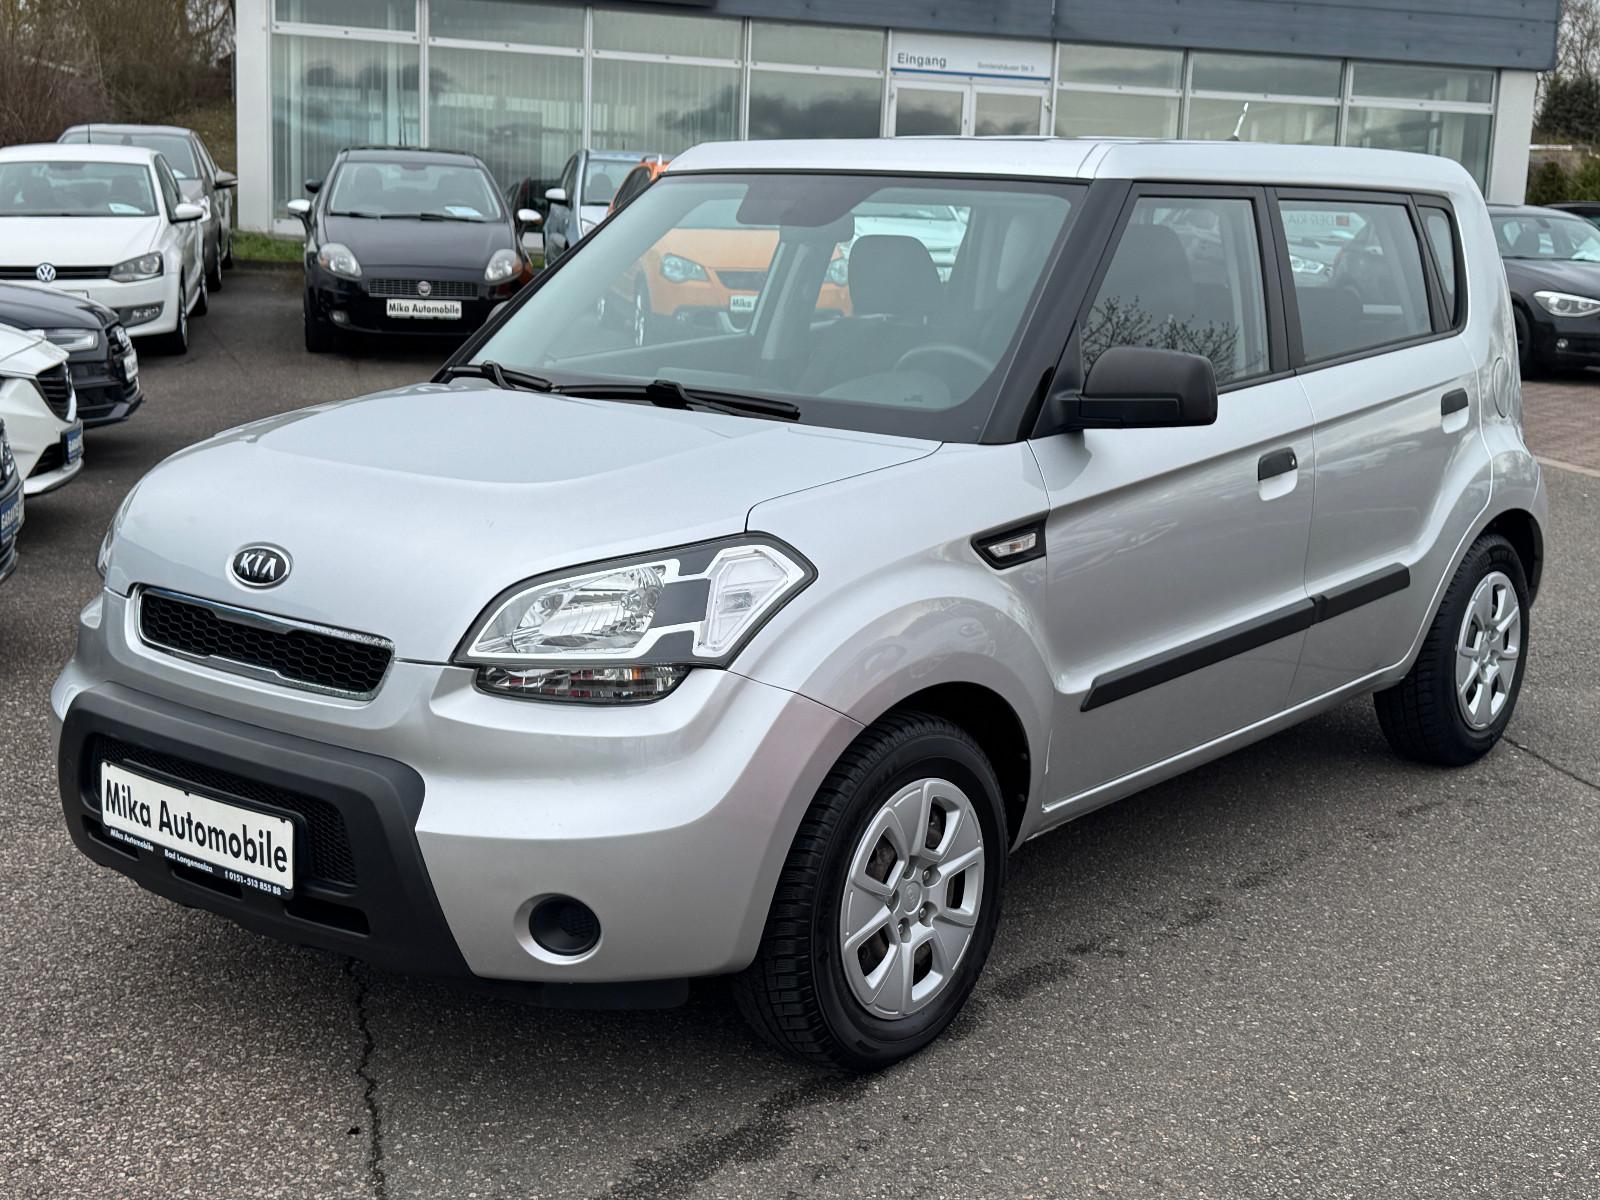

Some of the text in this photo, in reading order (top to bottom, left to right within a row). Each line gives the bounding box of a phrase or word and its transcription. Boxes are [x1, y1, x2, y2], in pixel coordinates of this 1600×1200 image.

[897, 53, 947, 68] Eingang
[389, 302, 460, 314] Mika Automobile
[238, 552, 277, 581] KIA
[105, 779, 288, 873] Mika Automobile
[110, 828, 154, 853] Mika Automobile
[164, 848, 176, 860] Bad
[259, 881, 272, 893] 855
